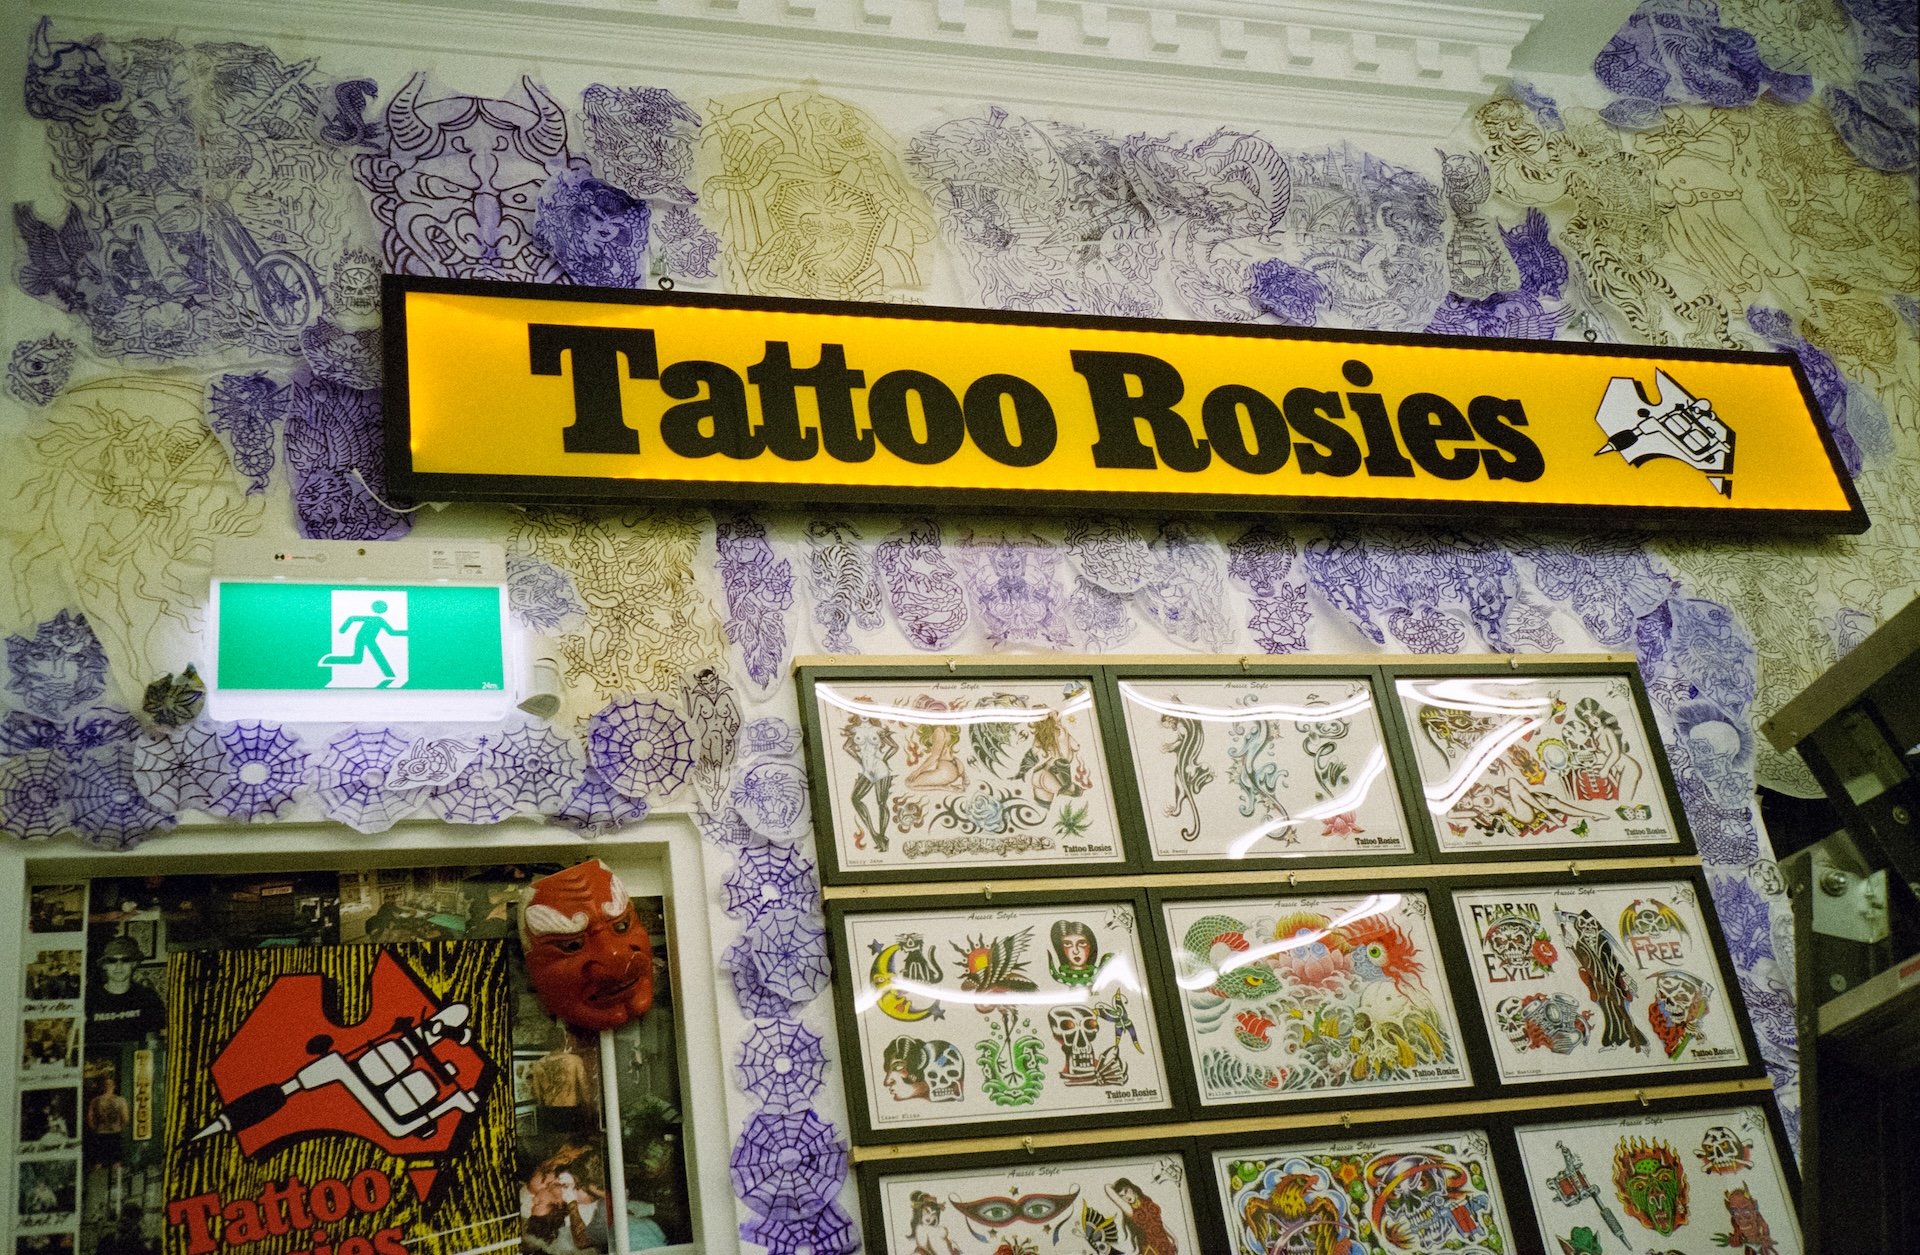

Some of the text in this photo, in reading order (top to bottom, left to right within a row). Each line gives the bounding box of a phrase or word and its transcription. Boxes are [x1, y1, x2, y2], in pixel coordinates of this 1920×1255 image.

[527, 322, 1547, 483] Tattoo Rosies
[1062, 843, 1112, 853] Tattoo Rosies
[1354, 836, 1401, 845] Tattoo Rosies
[1469, 902, 1541, 951] FEAR NO
[1483, 953, 1545, 983] EVIL
[1629, 936, 1684, 970] FREE
[1412, 1069, 1436, 1078] Tattoo
[1435, 1066, 1460, 1076] Rosies
[1105, 1087, 1158, 1099] Tattoo Rosies
[167, 1168, 392, 1255] Tattoo
